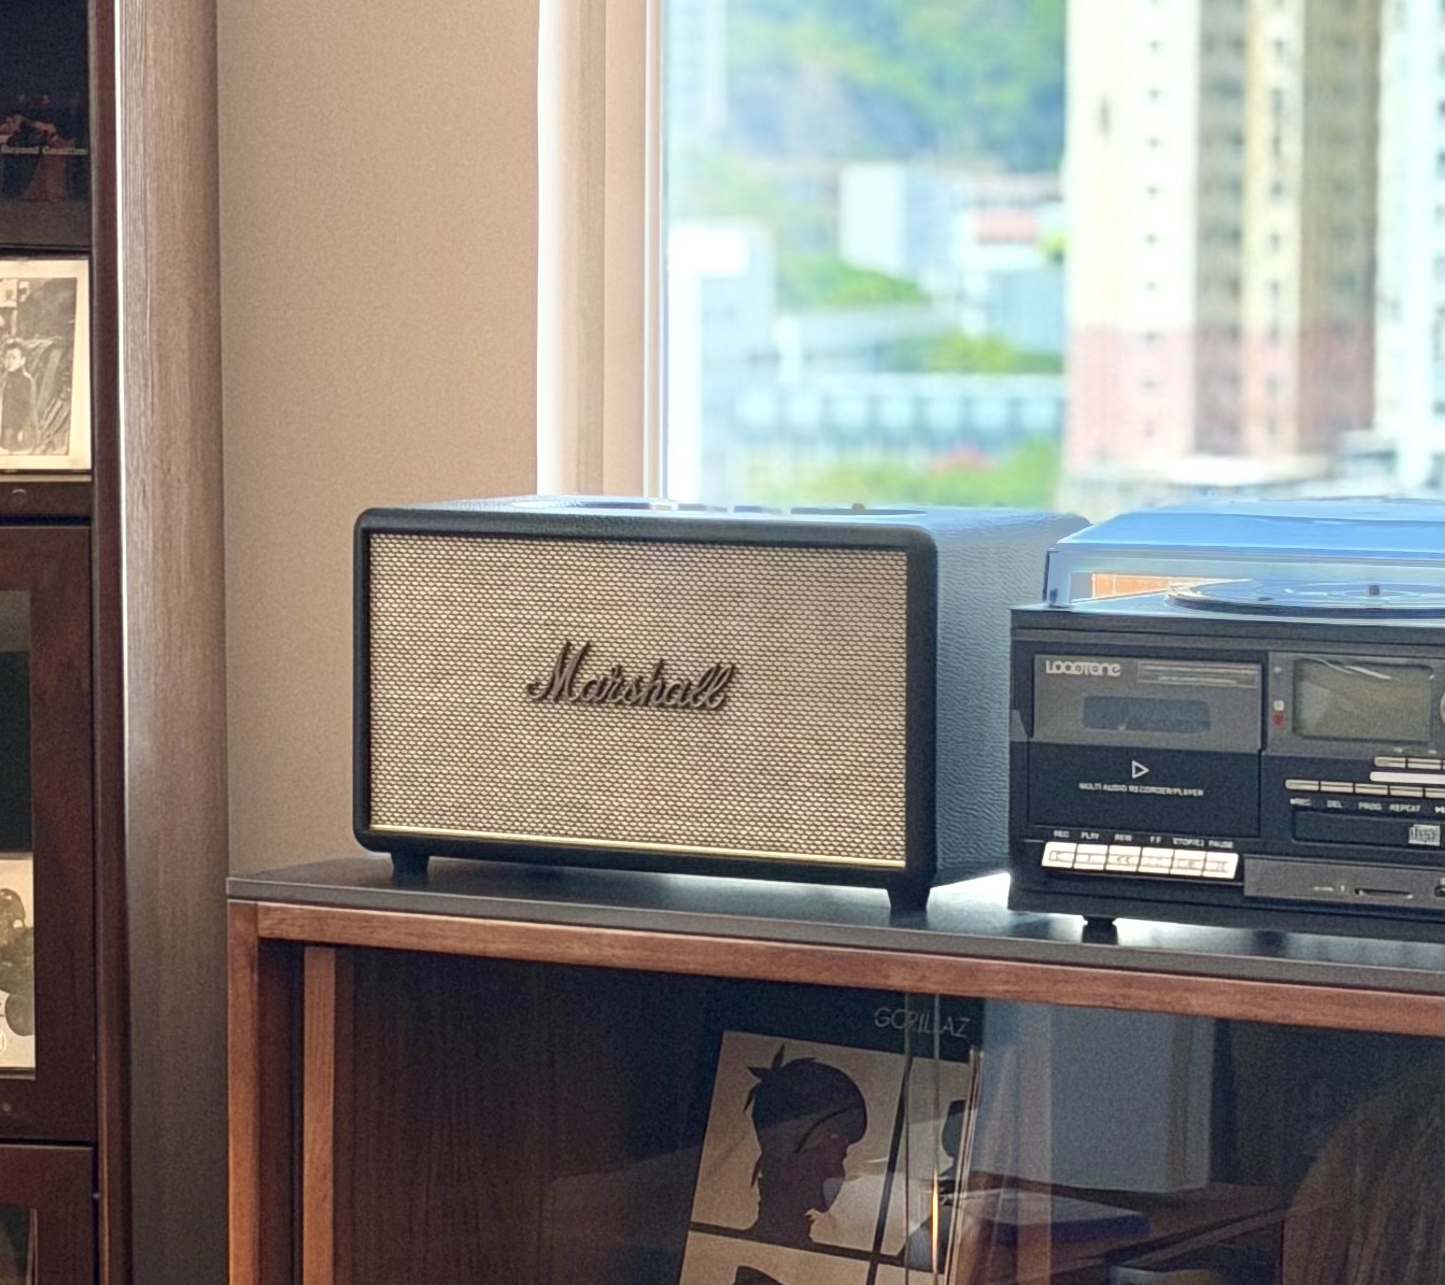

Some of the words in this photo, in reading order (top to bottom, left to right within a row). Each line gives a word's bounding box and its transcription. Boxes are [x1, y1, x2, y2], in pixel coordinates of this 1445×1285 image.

[525, 639, 737, 711] Marshall
[1080, 831, 1100, 841] PLAY
[873, 1006, 972, 1039] GORILAZ
